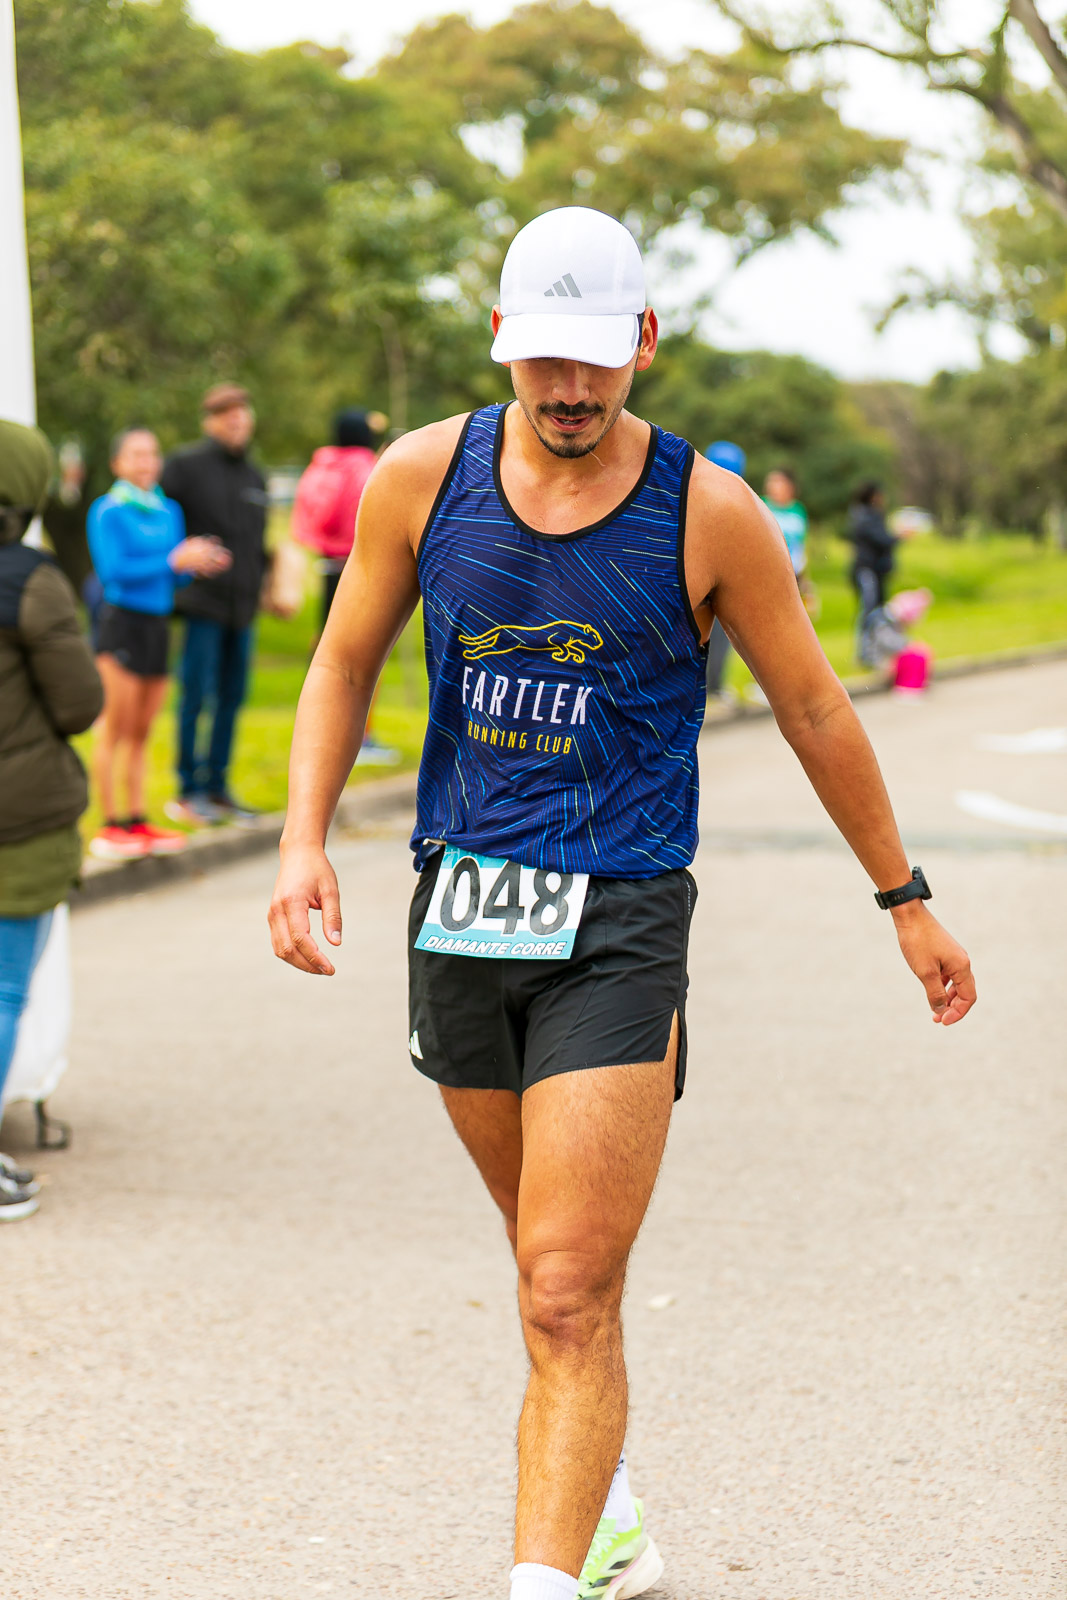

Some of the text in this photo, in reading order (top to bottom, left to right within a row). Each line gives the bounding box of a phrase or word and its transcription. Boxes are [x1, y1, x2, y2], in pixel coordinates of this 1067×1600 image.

[462, 666, 593, 725] FARTLEK
[467, 720, 572, 754] RUNNING CLUB
[440, 857, 573, 935] 048
[423, 936, 567, 956] DIAMANTE CORRE
